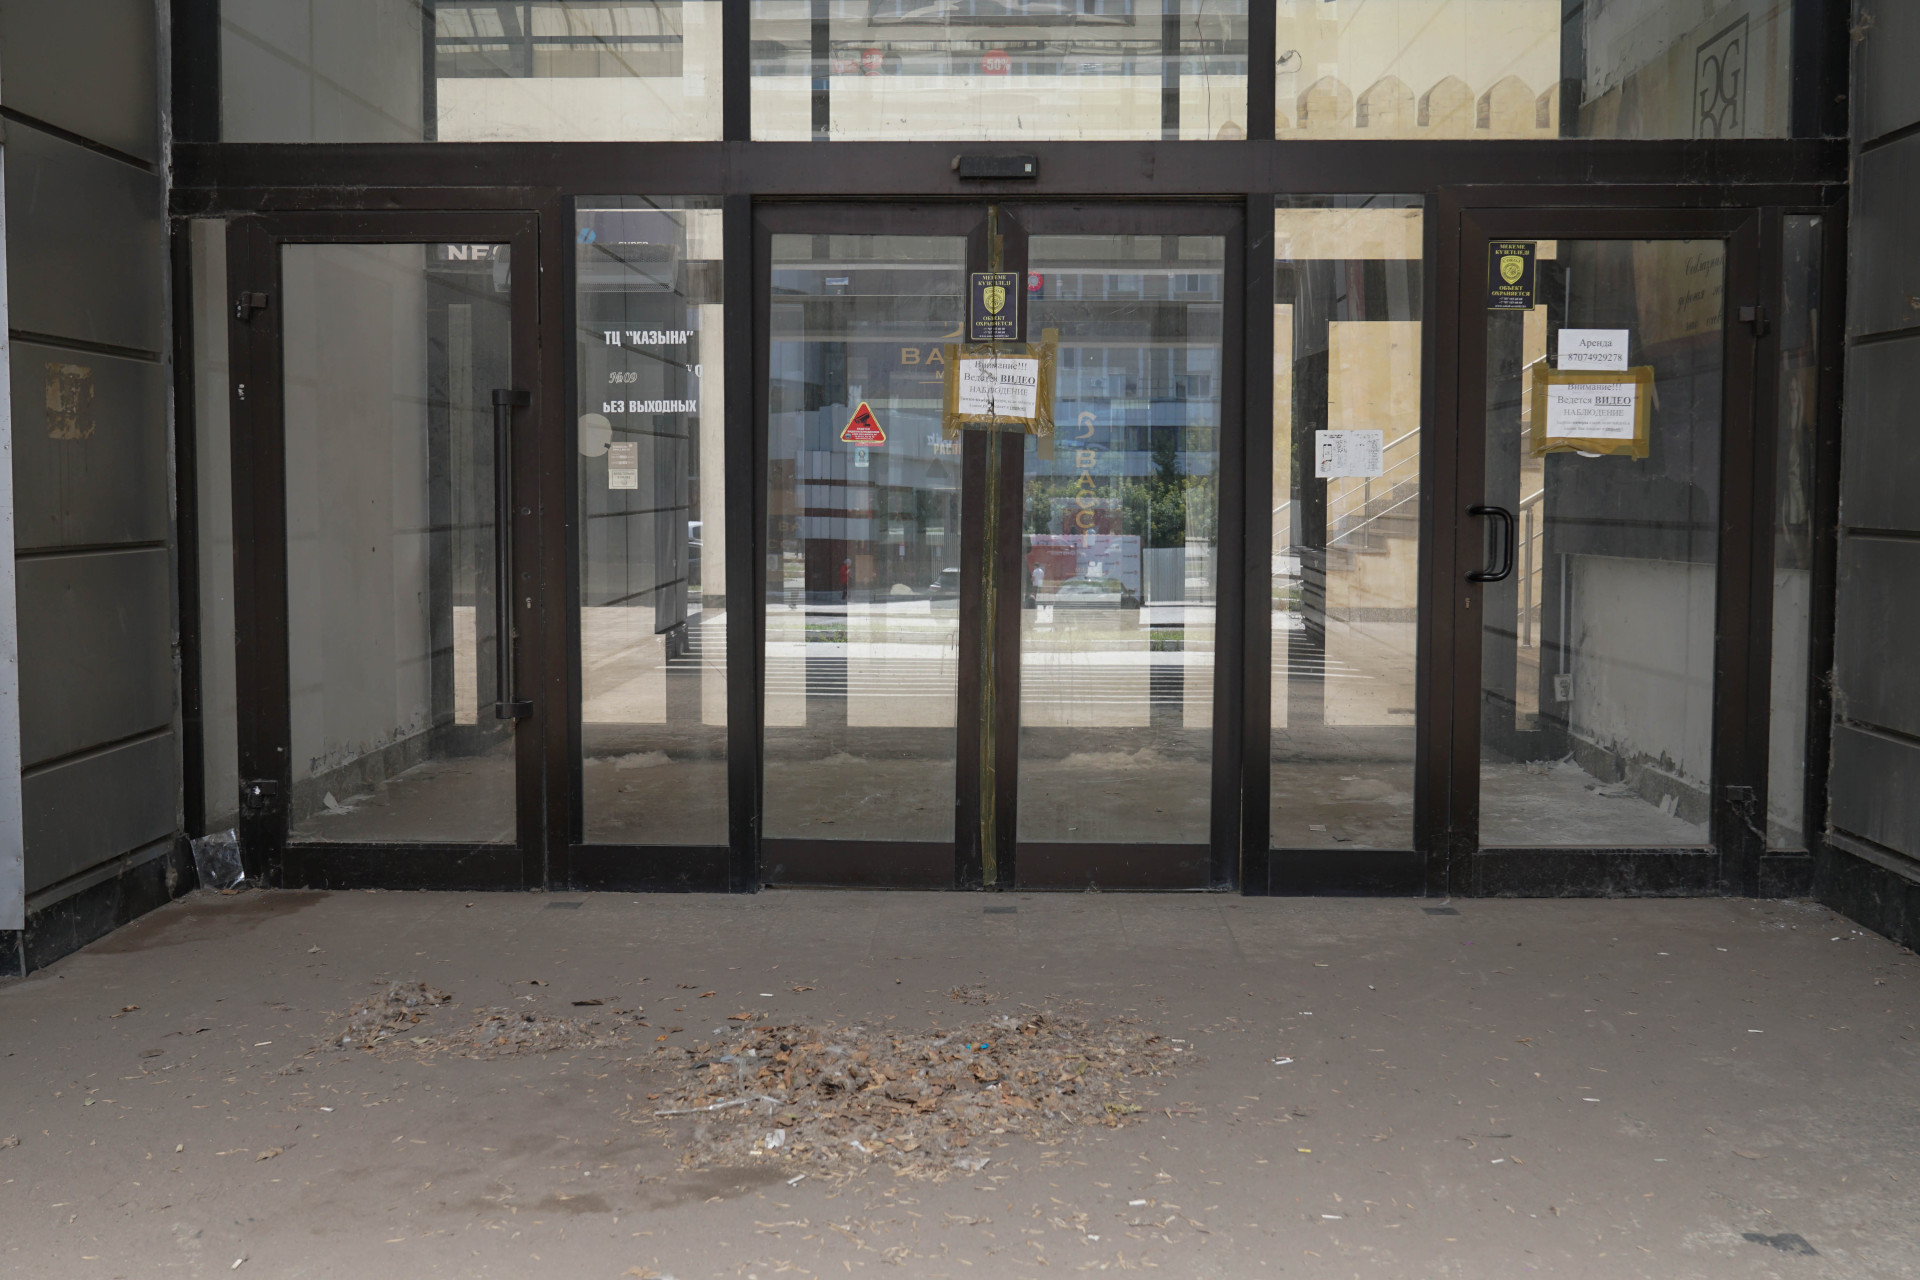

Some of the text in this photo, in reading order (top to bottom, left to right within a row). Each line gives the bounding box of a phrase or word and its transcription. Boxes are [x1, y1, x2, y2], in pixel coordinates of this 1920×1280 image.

[604, 331, 694, 346] ТЦ "КАЗЫНА"
[1579, 339, 1612, 348] Аренда
[1568, 353, 1623, 362] 87074929278
[1000, 374, 1036, 386] ВИДЕО
[1557, 396, 1632, 406] Ведется ВИДЕО
[629, 400, 696, 414] ВЫХОДНЫХ
[1564, 408, 1624, 416] НАБЛЮДЕНИЕ
